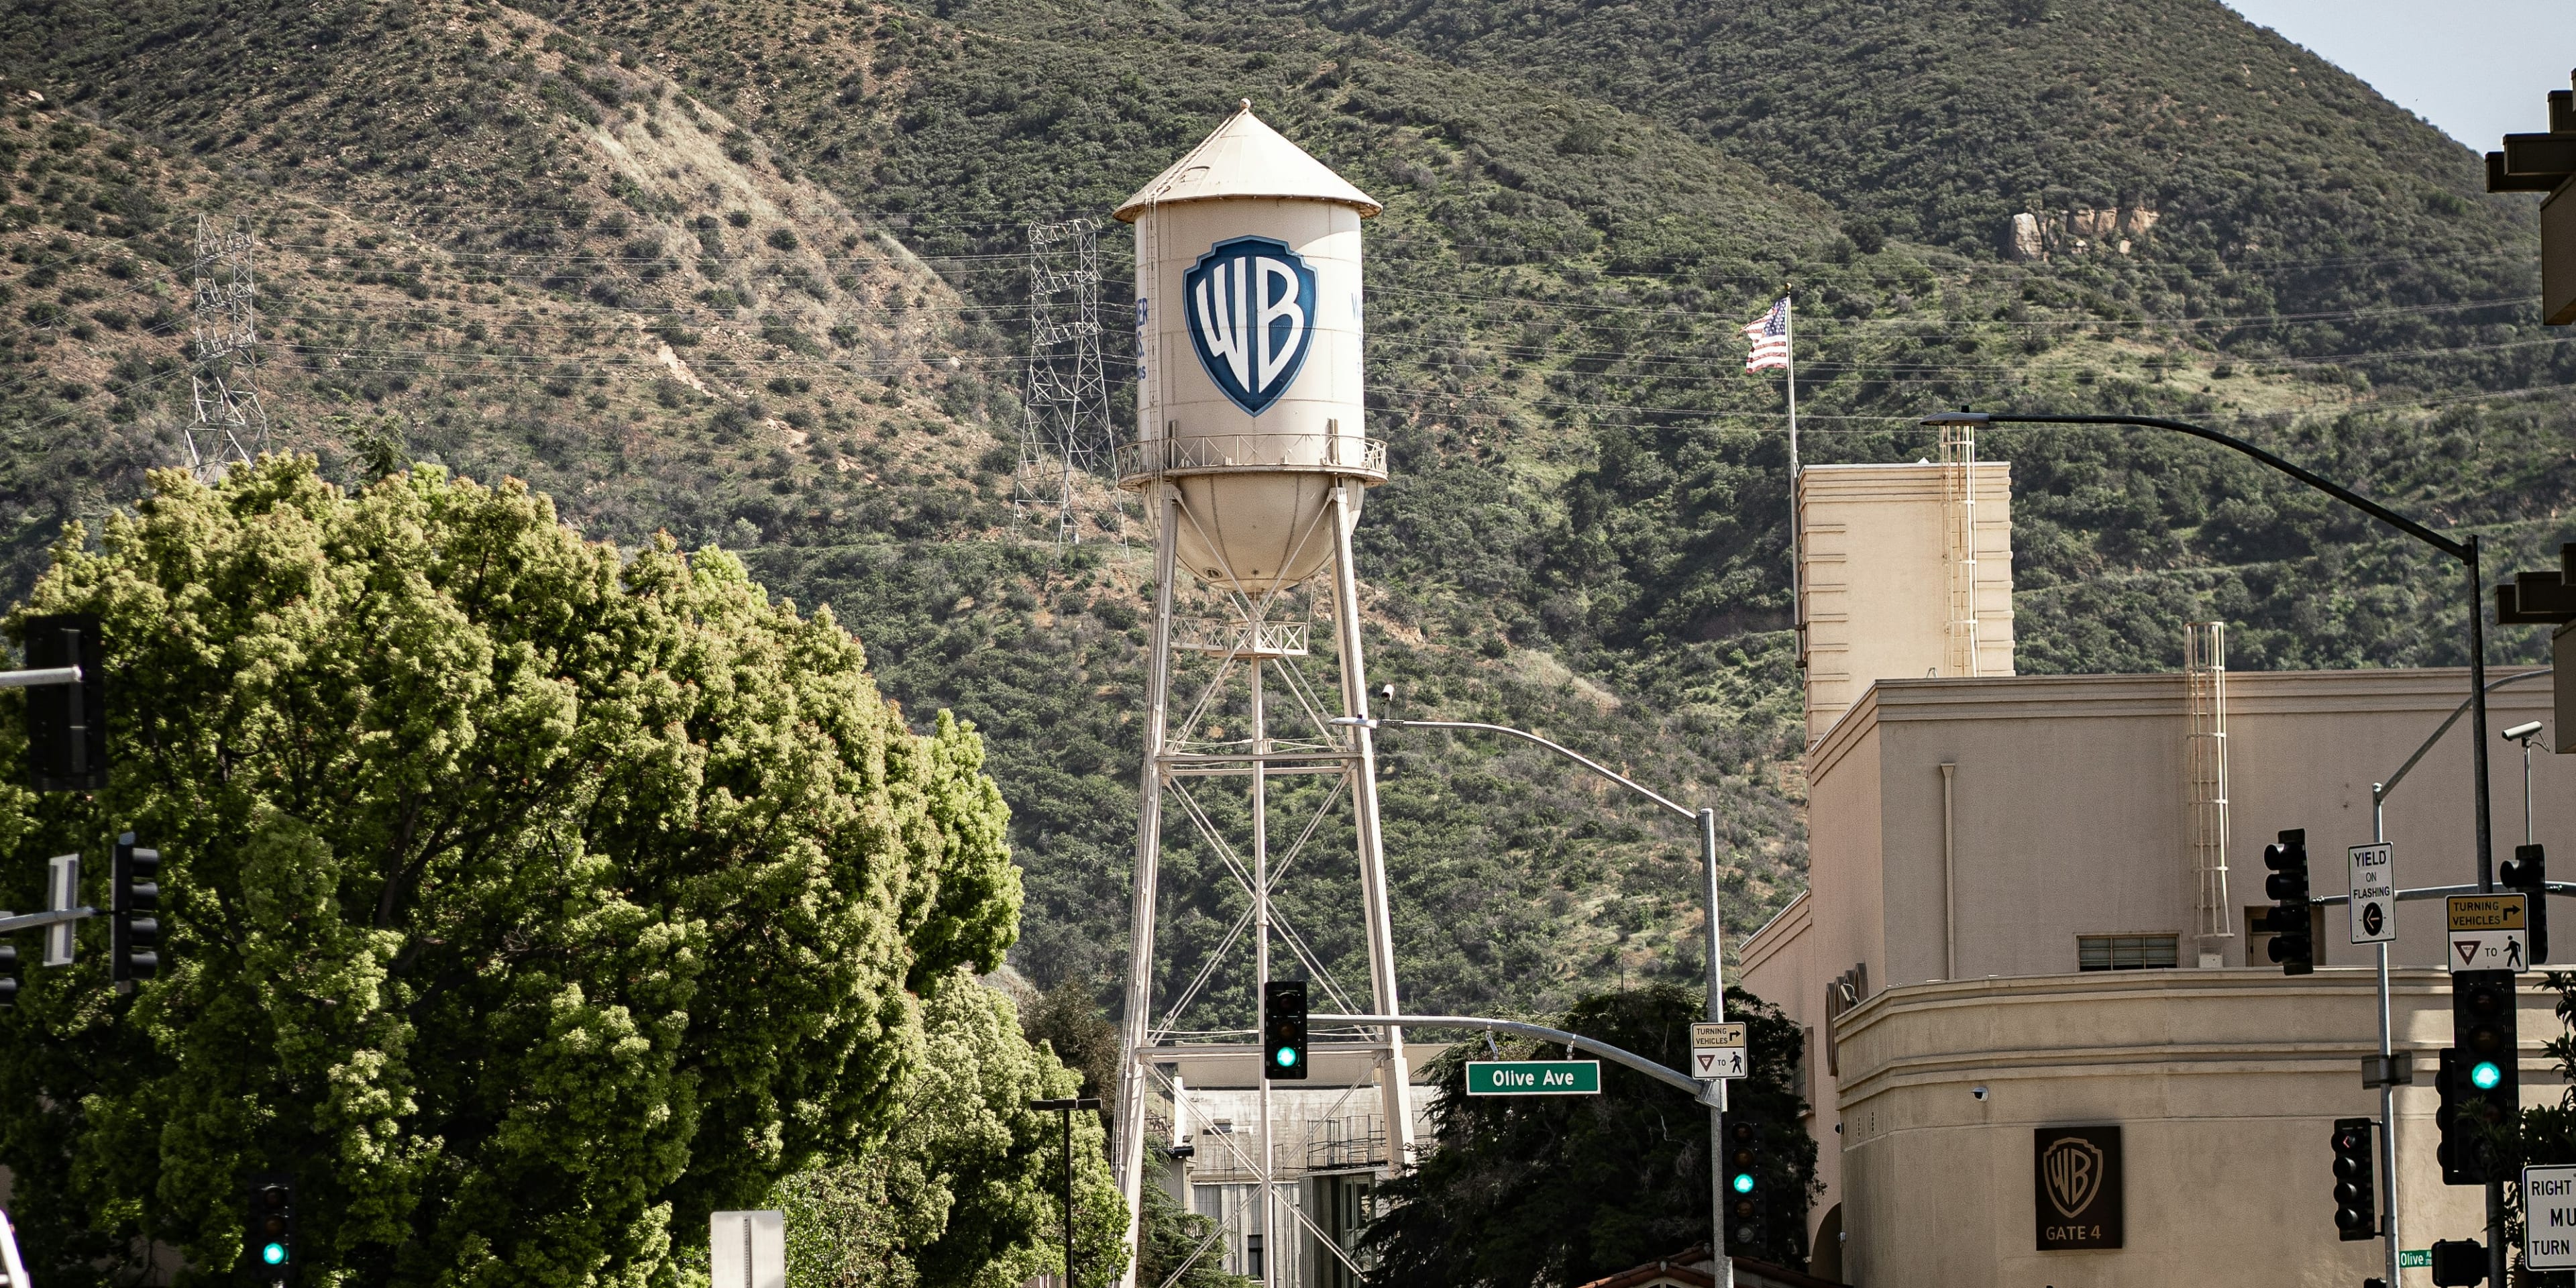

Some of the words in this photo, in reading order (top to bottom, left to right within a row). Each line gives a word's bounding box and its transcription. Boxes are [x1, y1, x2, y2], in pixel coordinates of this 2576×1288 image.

[1196, 256, 1304, 394] WB
[2354, 850, 2387, 867] YIELD
[2365, 871, 2377, 883] ON
[2353, 885, 2390, 899] FLASHING
[2453, 901, 2500, 912] TURNING
[2453, 915, 2501, 926] VEHICLES
[2485, 947, 2498, 957] TO
[1717, 1059, 1727, 1067] TO
[1493, 1070, 1535, 1086] Olive
[1542, 1069, 1574, 1085] Ave
[2051, 1148, 2091, 1205] WB
[2532, 1180, 2571, 1195] RIGHT
[2551, 1208, 2576, 1227] MU
[2046, 1226, 2086, 1240] GATE
[2090, 1225, 2101, 1239] 4
[2532, 1240, 2570, 1256] TURN
[2400, 1252, 2424, 1267] Olive
